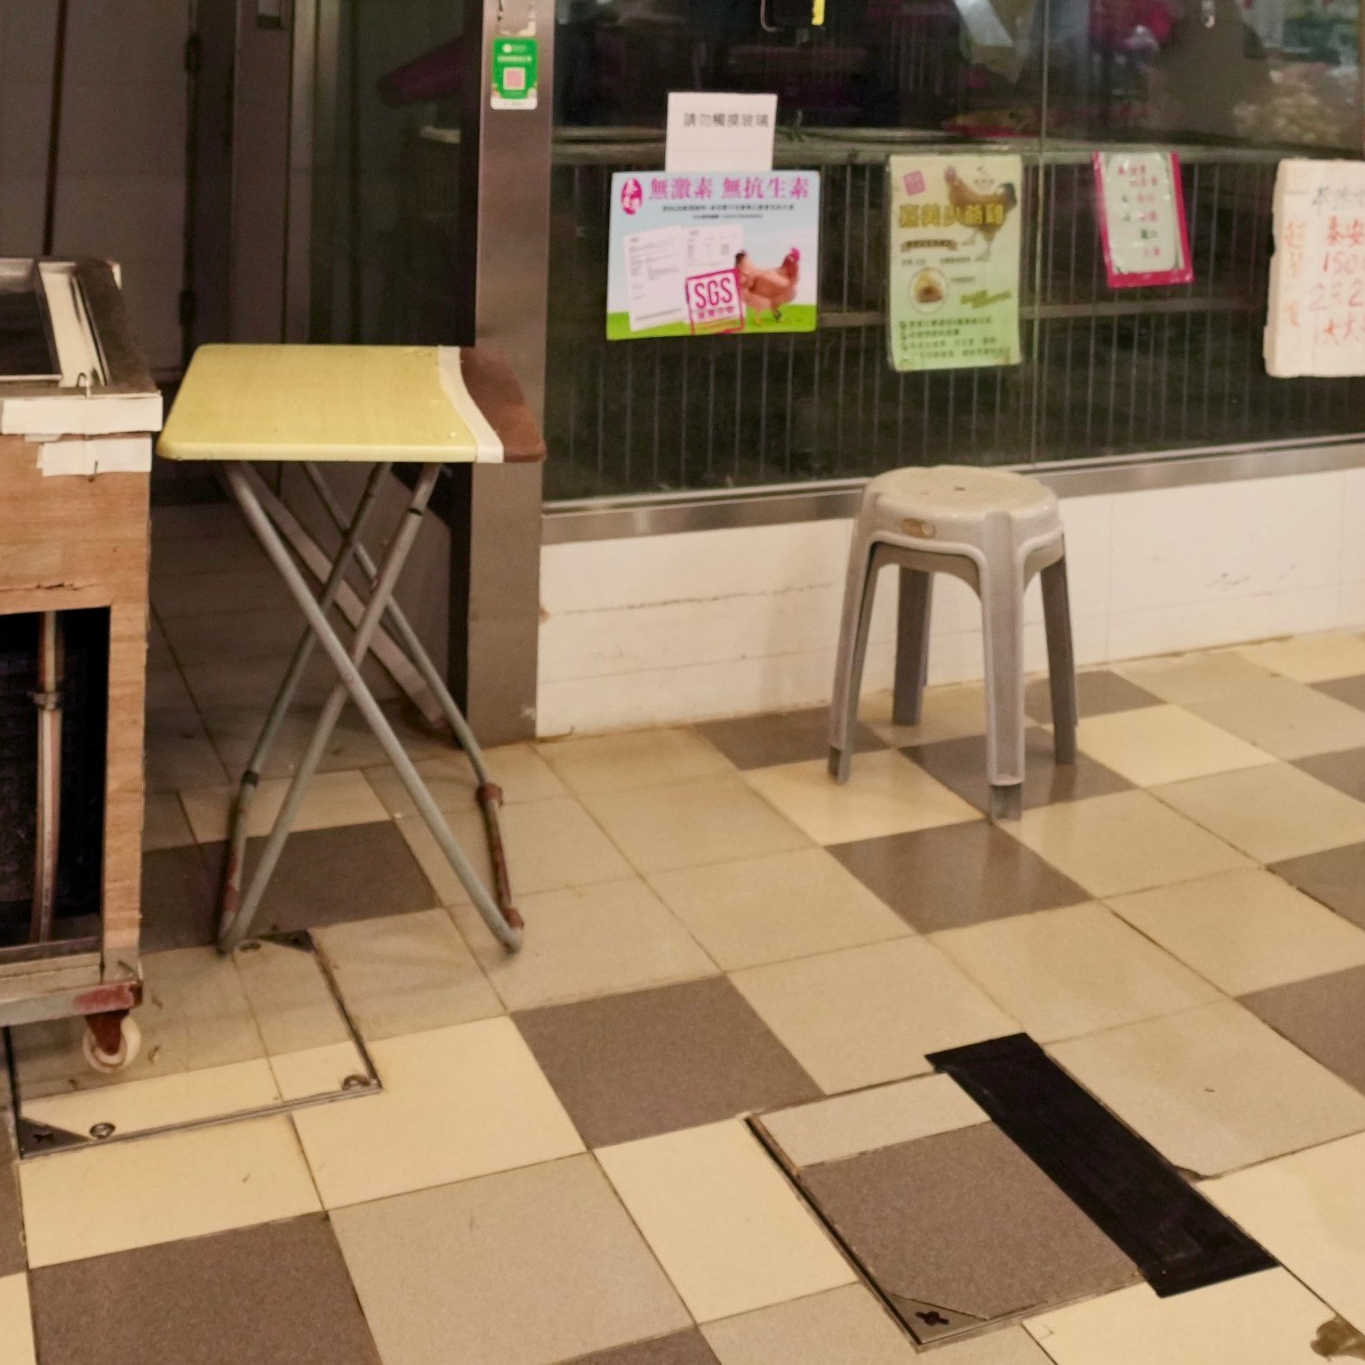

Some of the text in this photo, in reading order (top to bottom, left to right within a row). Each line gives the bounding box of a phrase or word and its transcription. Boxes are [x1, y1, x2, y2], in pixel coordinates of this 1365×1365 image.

[648, 176, 810, 201] 無激素 無抗生素
[694, 277, 733, 309] SGS
